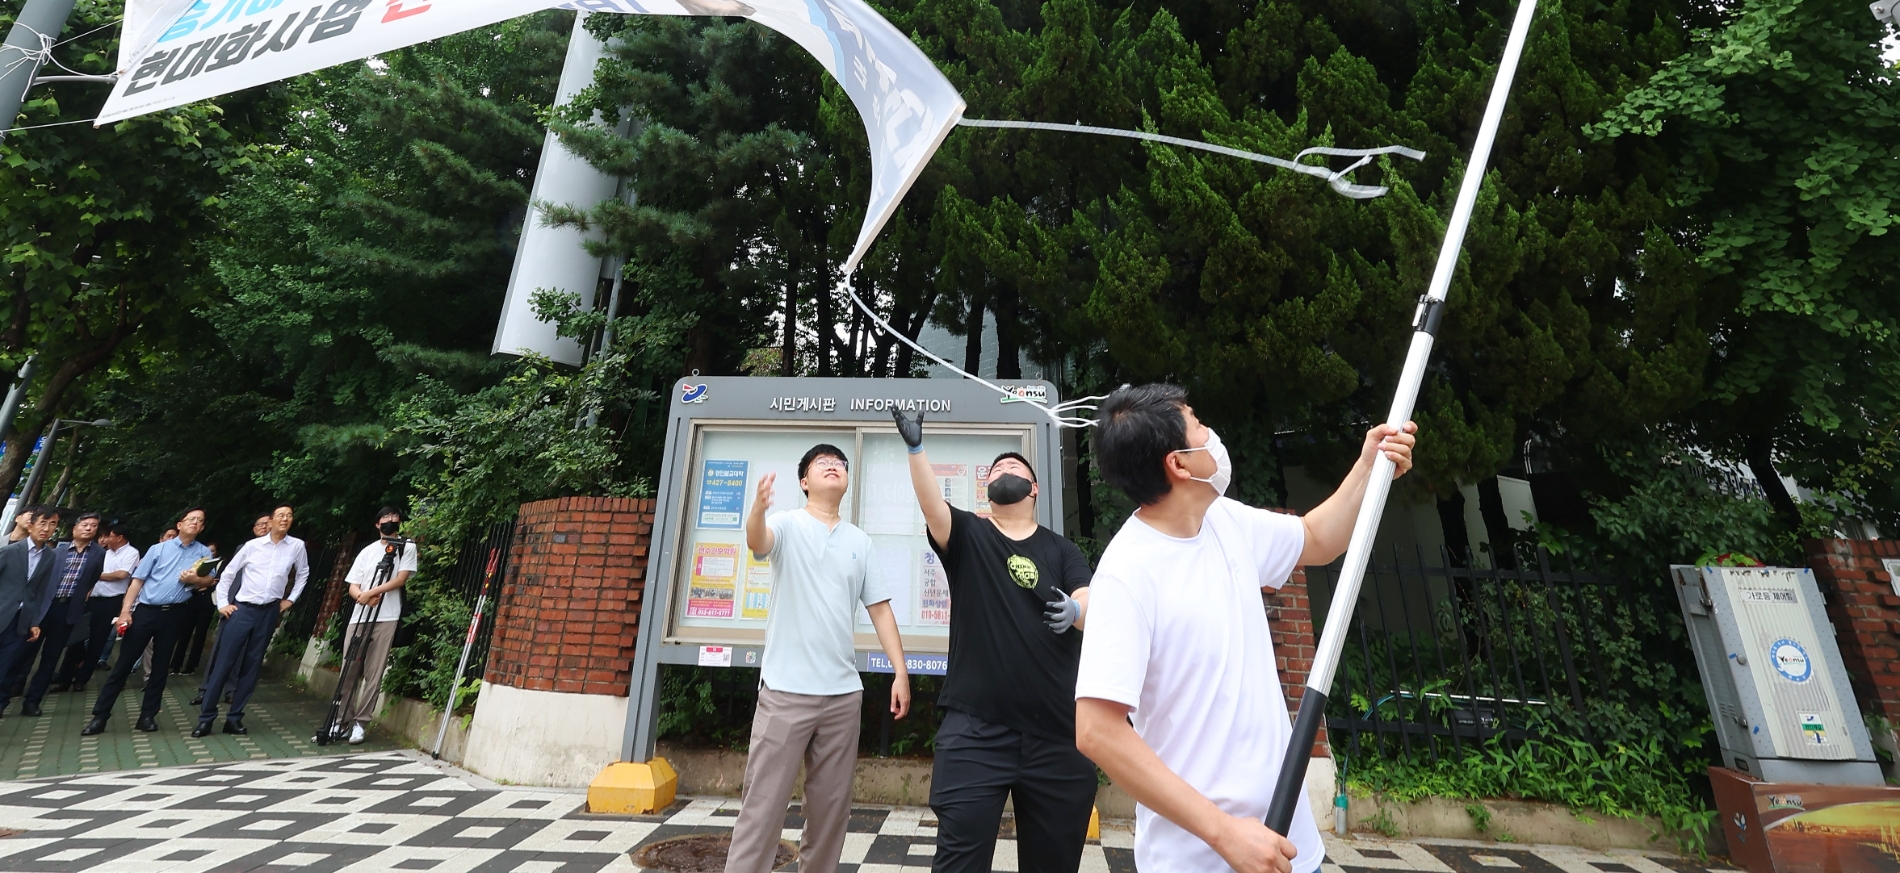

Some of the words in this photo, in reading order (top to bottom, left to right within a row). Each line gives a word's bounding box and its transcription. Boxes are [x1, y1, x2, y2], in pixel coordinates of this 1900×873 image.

[122, 0, 373, 97] 현대화사업
[769, 396, 836, 411] 시민게시판
[850, 398, 951, 412] INFORMATION
[924, 568, 936, 577] 사주
